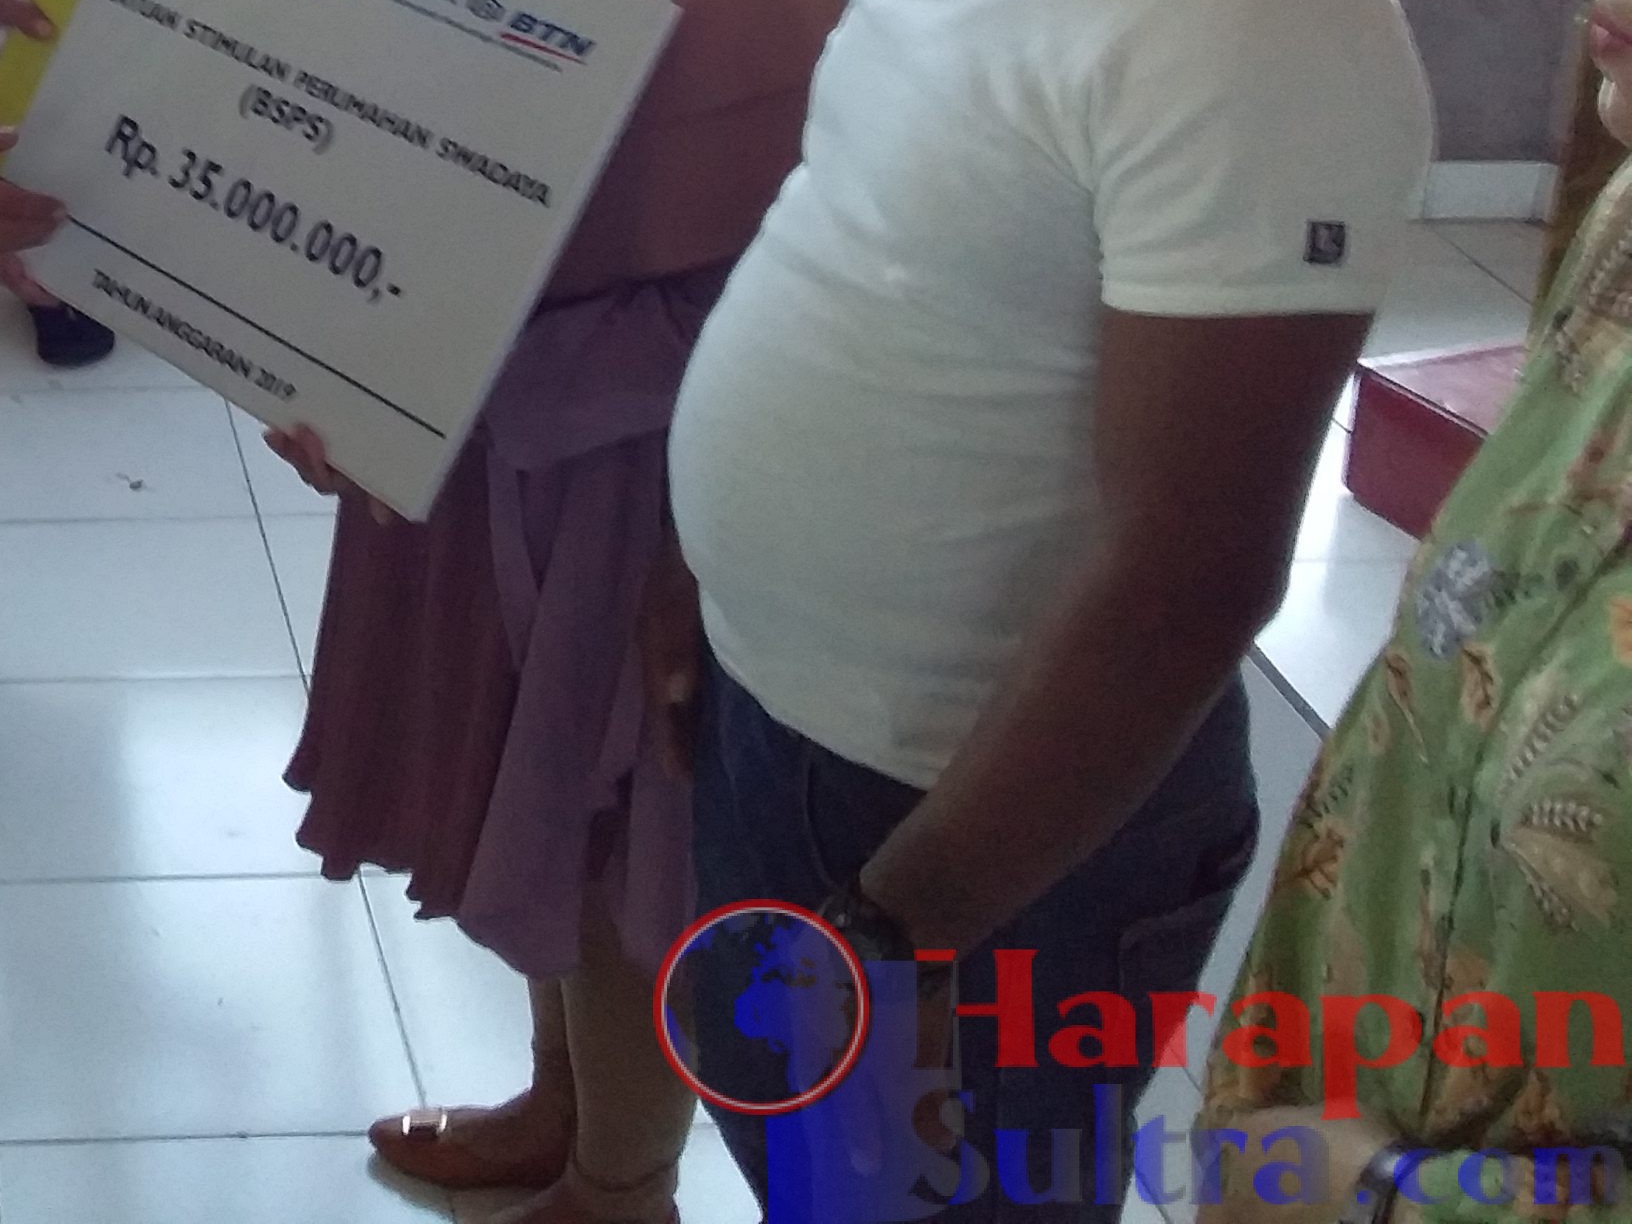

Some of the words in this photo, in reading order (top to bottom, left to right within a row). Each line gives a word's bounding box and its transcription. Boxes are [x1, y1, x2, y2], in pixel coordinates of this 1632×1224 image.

[508, 10, 597, 56] BTN
[183, 18, 292, 81] STIMULAN
[292, 69, 435, 151] PERUMAHAN
[435, 136, 552, 208] SWADAYA
[238, 83, 335, 156] (BSPS)
[102, 113, 161, 178] Rp.
[168, 149, 402, 304] 35.000.000,-
[92, 269, 151, 316] TAHUN
[147, 300, 253, 376] ANGGARAN
[252, 358, 297, 401] 2019
